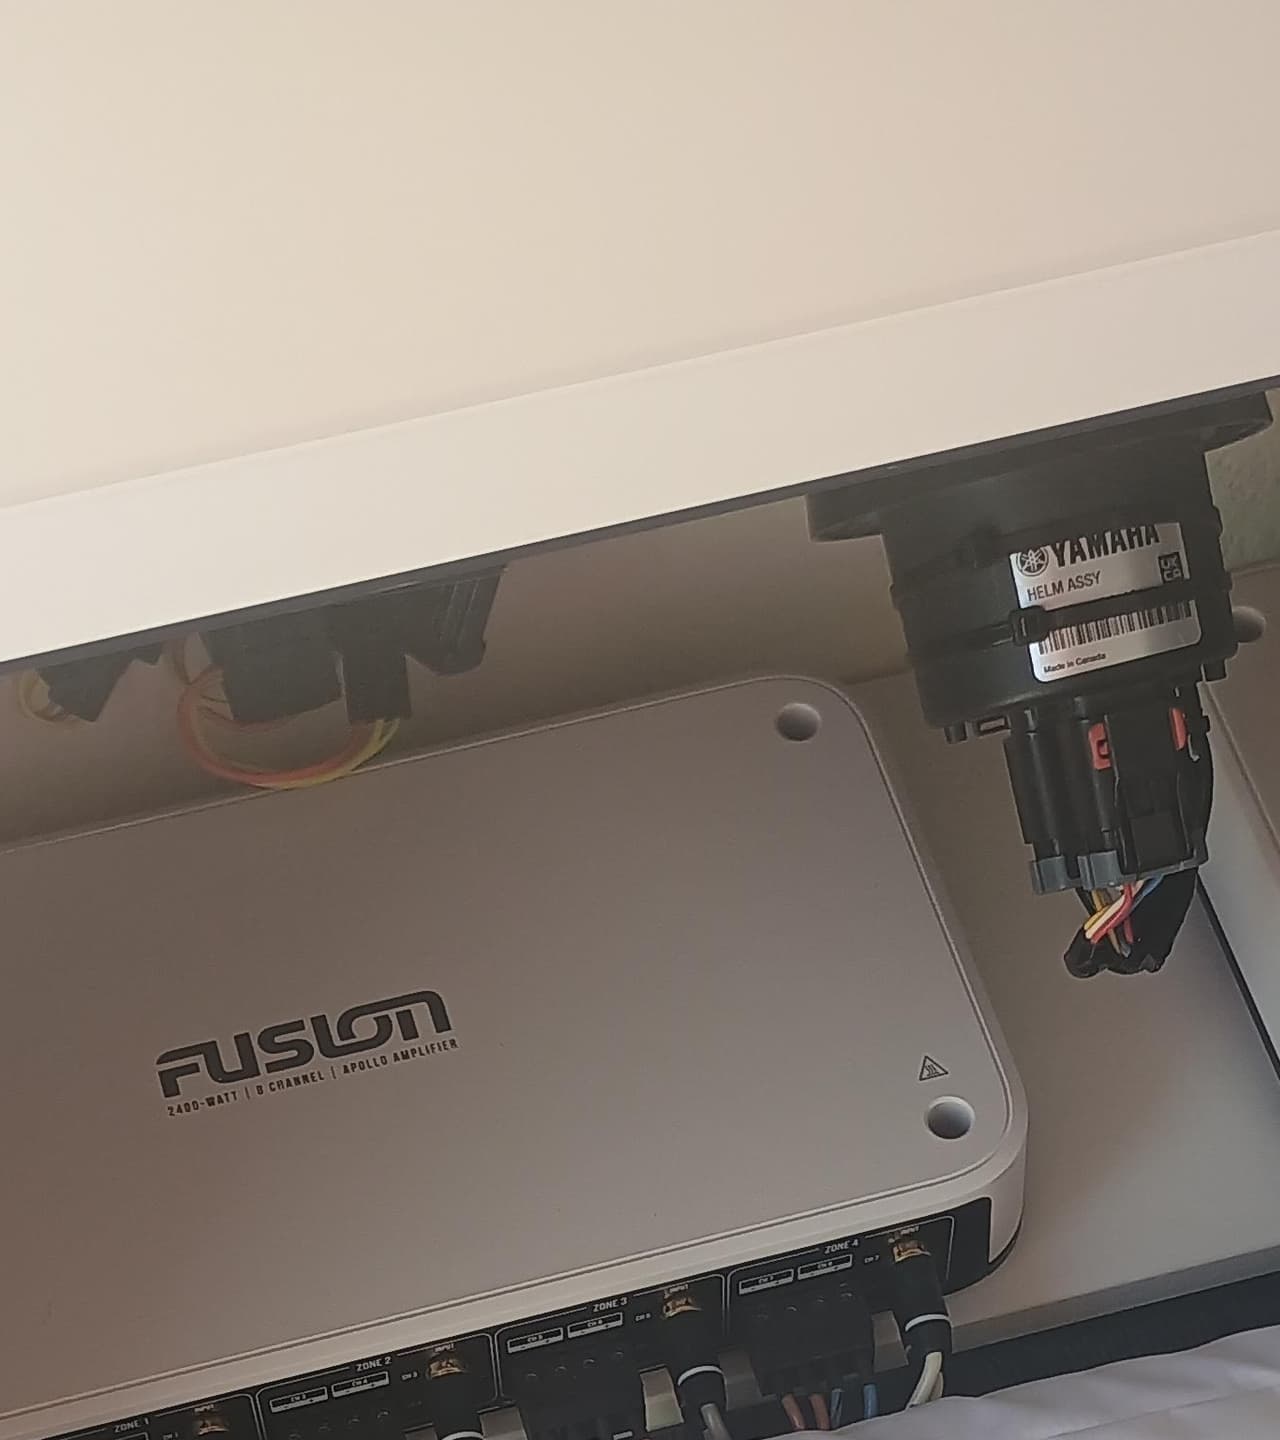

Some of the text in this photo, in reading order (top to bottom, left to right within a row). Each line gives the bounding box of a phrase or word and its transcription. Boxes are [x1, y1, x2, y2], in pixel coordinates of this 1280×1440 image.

[1051, 523, 1160, 567] YAMAHA
[1027, 570, 1102, 601] HELM ASSY
[1043, 652, 1106, 674] Made in Canada
[155, 990, 452, 1098] FUSION
[168, 1090, 239, 1117] 2400-WATT
[268, 1070, 325, 1093] CHANNEL
[343, 1056, 388, 1075] APOLLO
[393, 1038, 459, 1062] AMPLIFIER
[823, 1241, 850, 1254] ZONE
[592, 1299, 620, 1312] ZONE
[355, 1359, 383, 1372] ZONE
[112, 1419, 142, 1434] ZONE
